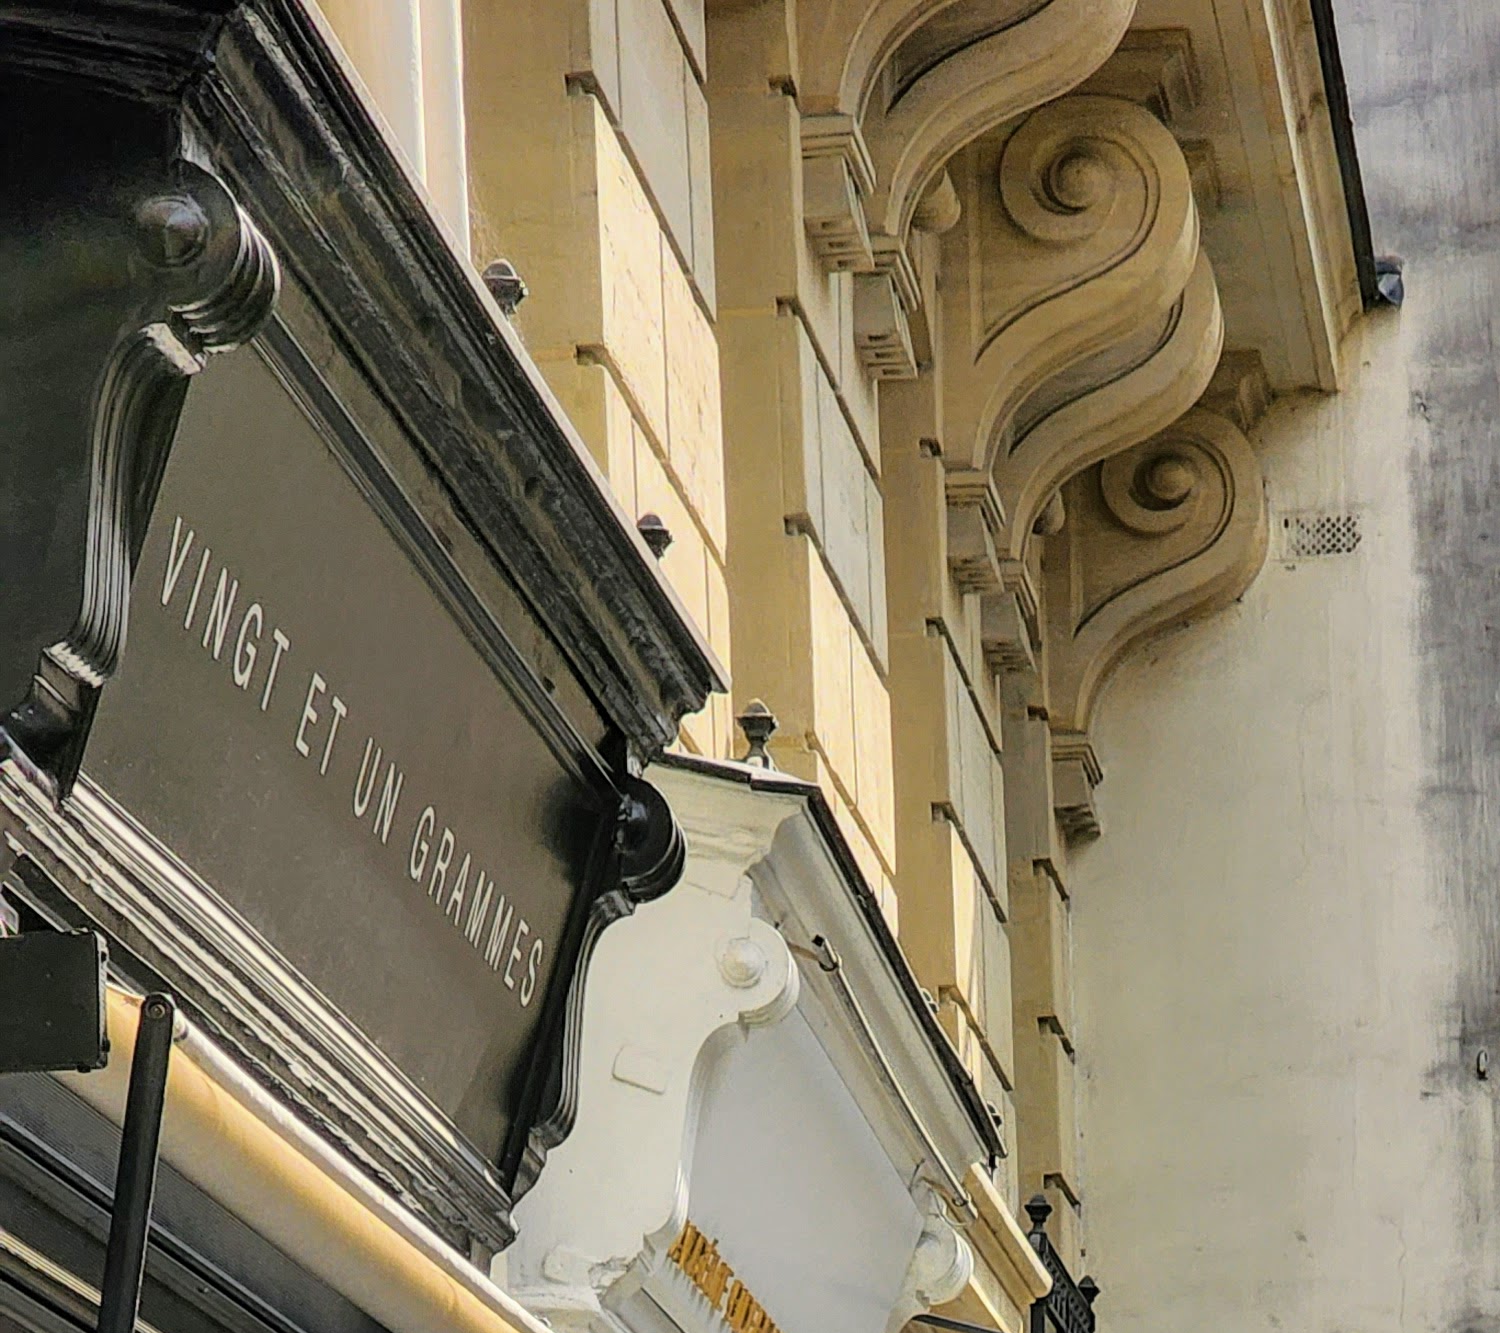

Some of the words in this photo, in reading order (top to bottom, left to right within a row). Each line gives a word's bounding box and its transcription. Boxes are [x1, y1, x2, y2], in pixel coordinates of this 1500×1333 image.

[159, 515, 292, 712] VINGT
[294, 672, 347, 777] ET
[352, 737, 407, 846] UN
[409, 804, 546, 1009] GRAMMES
